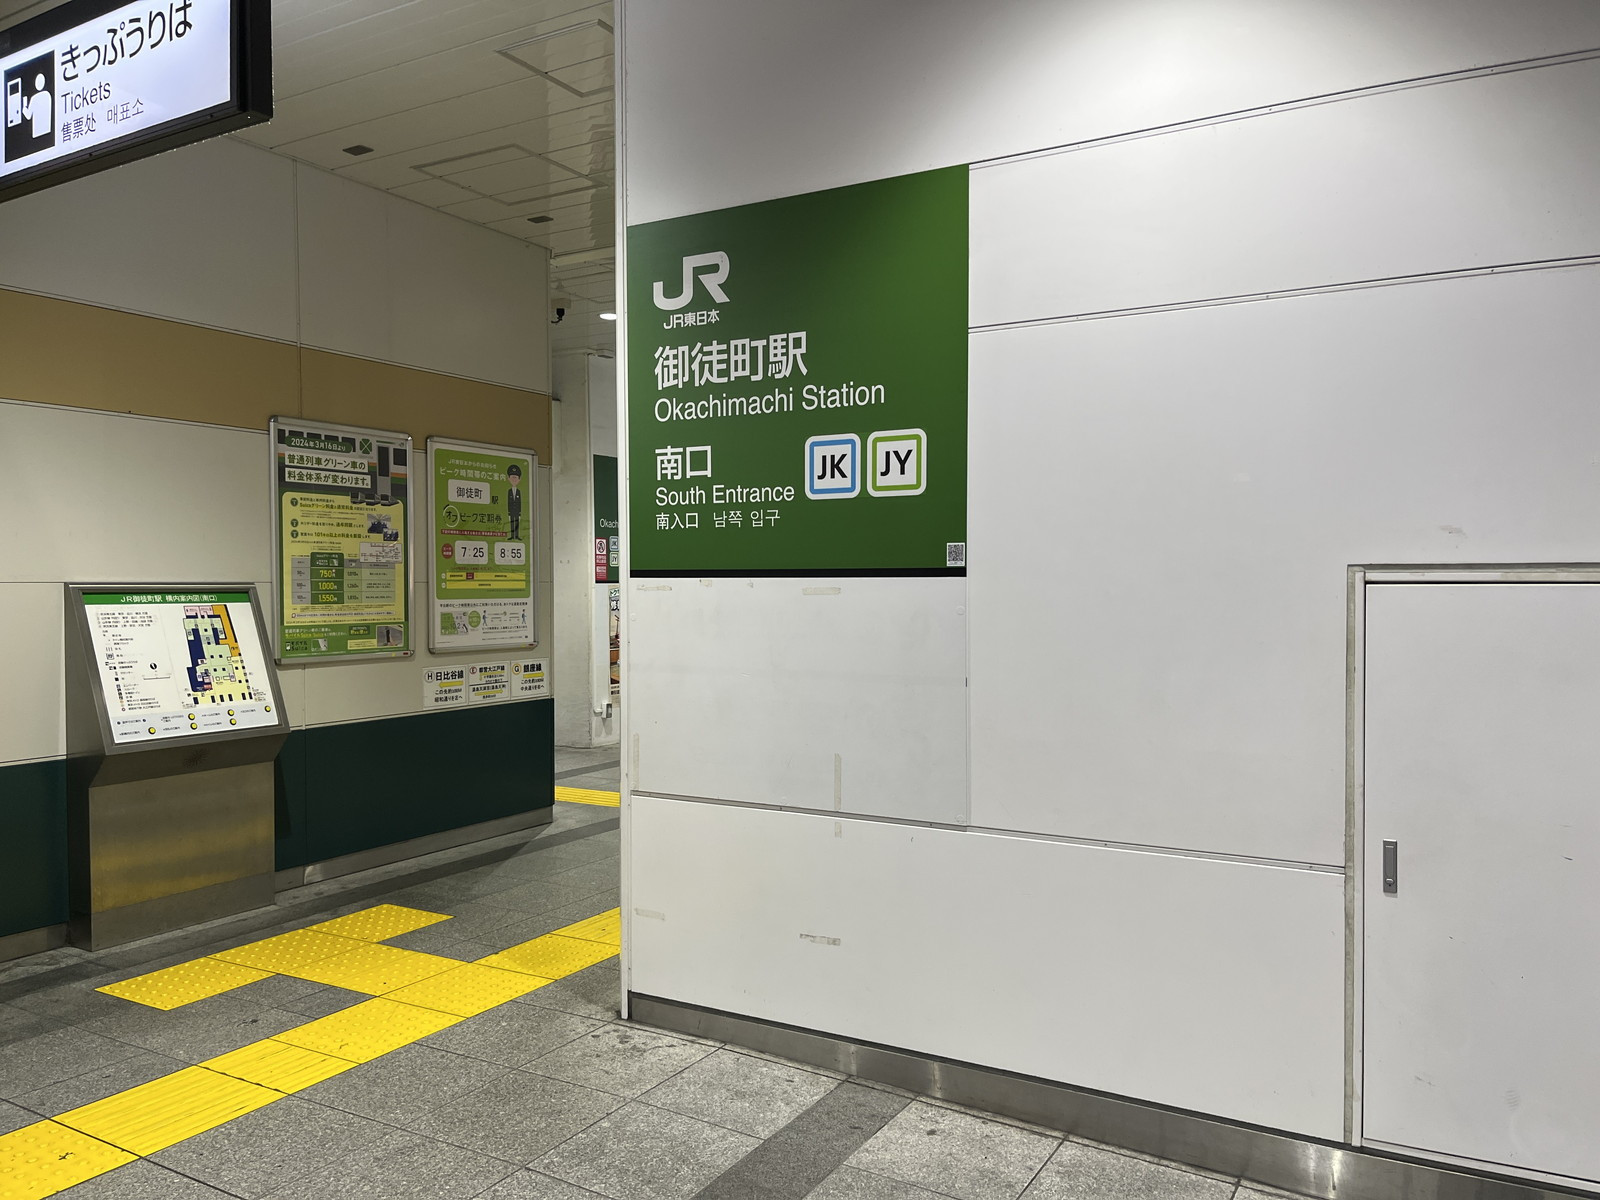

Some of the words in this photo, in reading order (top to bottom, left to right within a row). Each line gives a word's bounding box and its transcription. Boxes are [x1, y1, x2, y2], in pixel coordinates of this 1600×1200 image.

[60, 0, 194, 81] きっぷうりば
[61, 81, 112, 114] Tickets
[106, 98, 144, 124] 매표소
[60, 113, 97, 143] 售票处
[653, 250, 731, 311] JR
[663, 309, 720, 329] JR東日本
[654, 331, 808, 391] 御徒町駅
[654, 386, 794, 422] Okachimachi
[802, 381, 886, 411] Station
[291, 438, 346, 451] 2024年3月16日より
[287, 453, 366, 470] 普通列車グリーン車の
[655, 445, 712, 481] 南口
[817, 453, 848, 480] JK
[880, 449, 913, 477] JY
[287, 470, 369, 487] 料金体系が変わります。
[440, 466, 507, 481] ピーク時間帯のご案内
[456, 486, 483, 499] 御徒町
[655, 486, 706, 506] South
[712, 483, 795, 504] Entrance
[655, 512, 699, 530] 南入口
[713, 510, 743, 528] 남쪽
[750, 509, 780, 527] 입구
[461, 546, 485, 558] 7:25
[500, 548, 522, 559] 8:55
[120, 594, 163, 603] JR御徒町駅
[427, 673, 433, 681] H
[435, 670, 464, 681] 日比谷線
[523, 663, 542, 673] 銀座線
